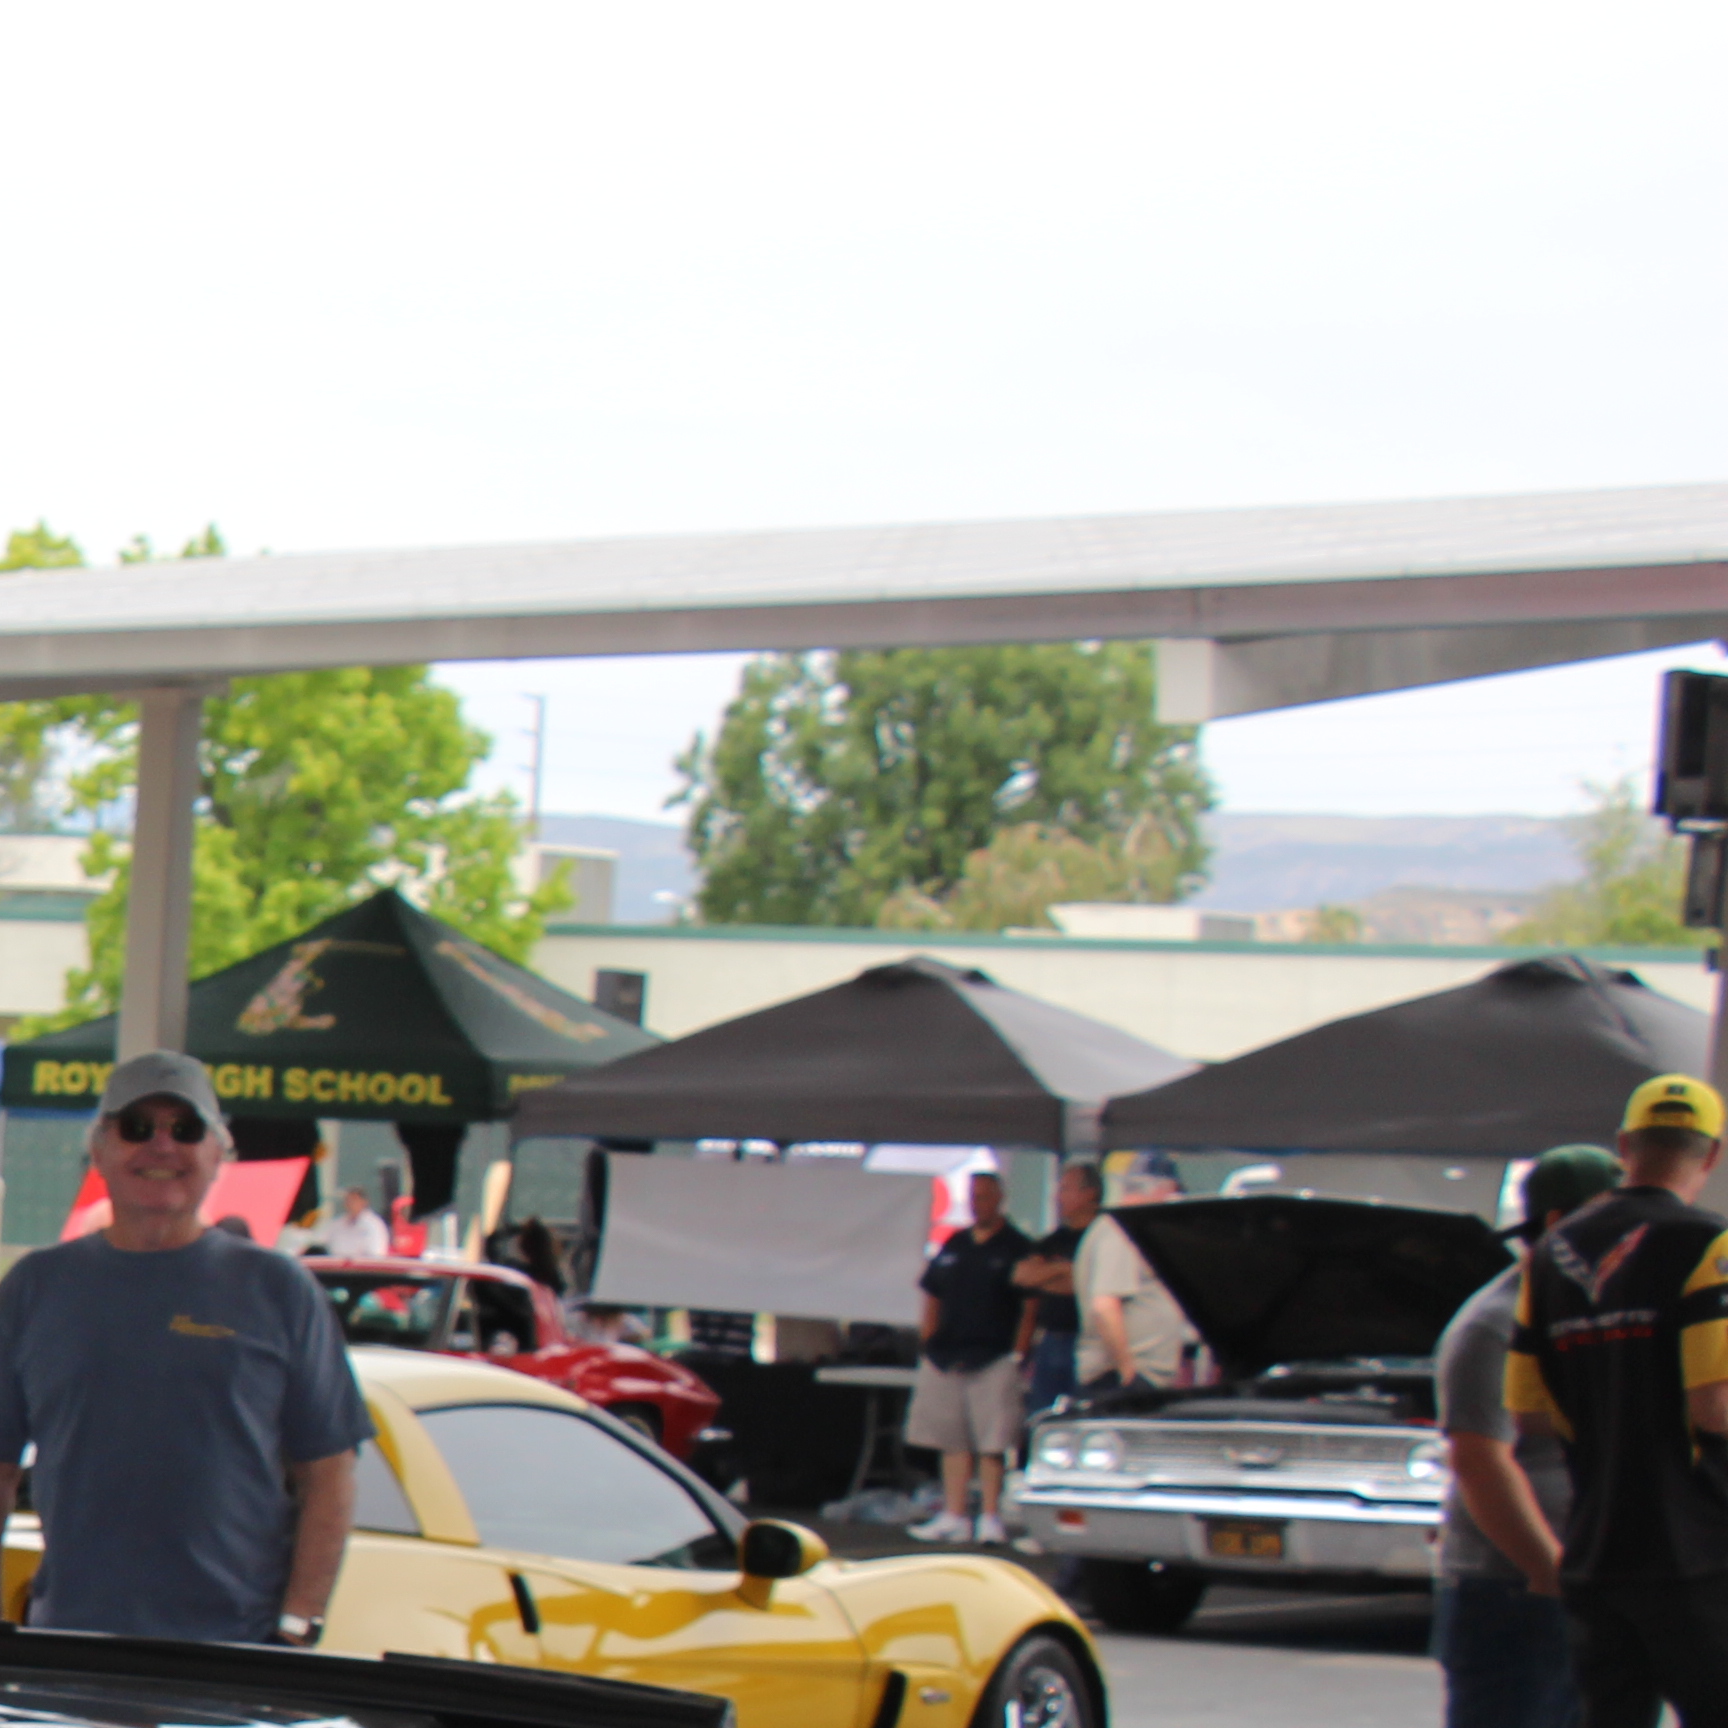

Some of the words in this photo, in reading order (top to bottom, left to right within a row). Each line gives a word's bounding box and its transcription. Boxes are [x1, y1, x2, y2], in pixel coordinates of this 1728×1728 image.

[33, 1060, 115, 1096] ROY
[203, 1061, 274, 1099] IGH
[283, 1065, 454, 1106] SCHOOL
